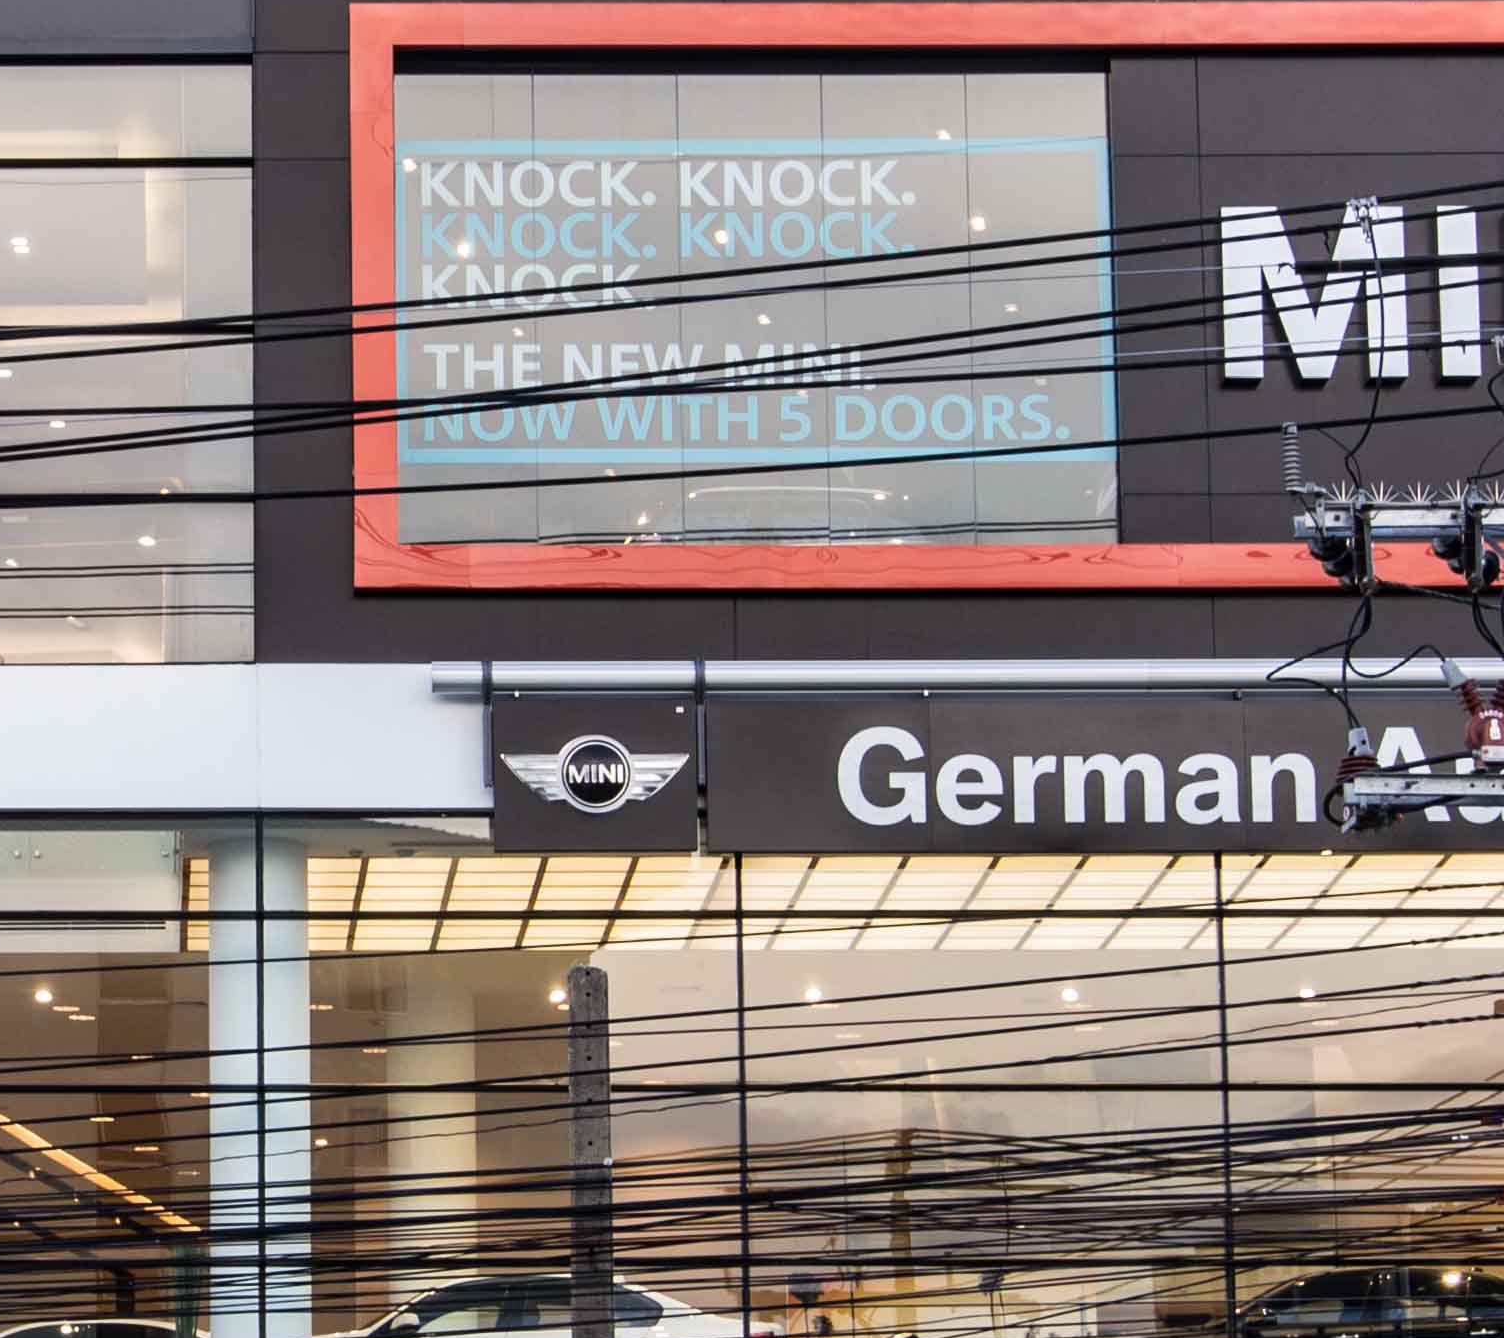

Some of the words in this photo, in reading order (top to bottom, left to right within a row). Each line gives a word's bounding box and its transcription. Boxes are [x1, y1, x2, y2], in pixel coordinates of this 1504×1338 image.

[419, 159, 657, 207] KNOCK.
[679, 157, 916, 206] KNOCK.
[420, 211, 658, 259] KNOCK.
[679, 210, 917, 259] KNOCK.
[420, 263, 658, 312] KNOCK.
[423, 343, 544, 391] THE
[563, 342, 704, 391] NEW
[423, 397, 575, 444] NOW
[580, 396, 760, 443] WITH
[778, 395, 812, 442] 5
[834, 394, 1071, 442] DOORS.
[568, 763, 624, 784] MINI
[837, 725, 1318, 826] German
